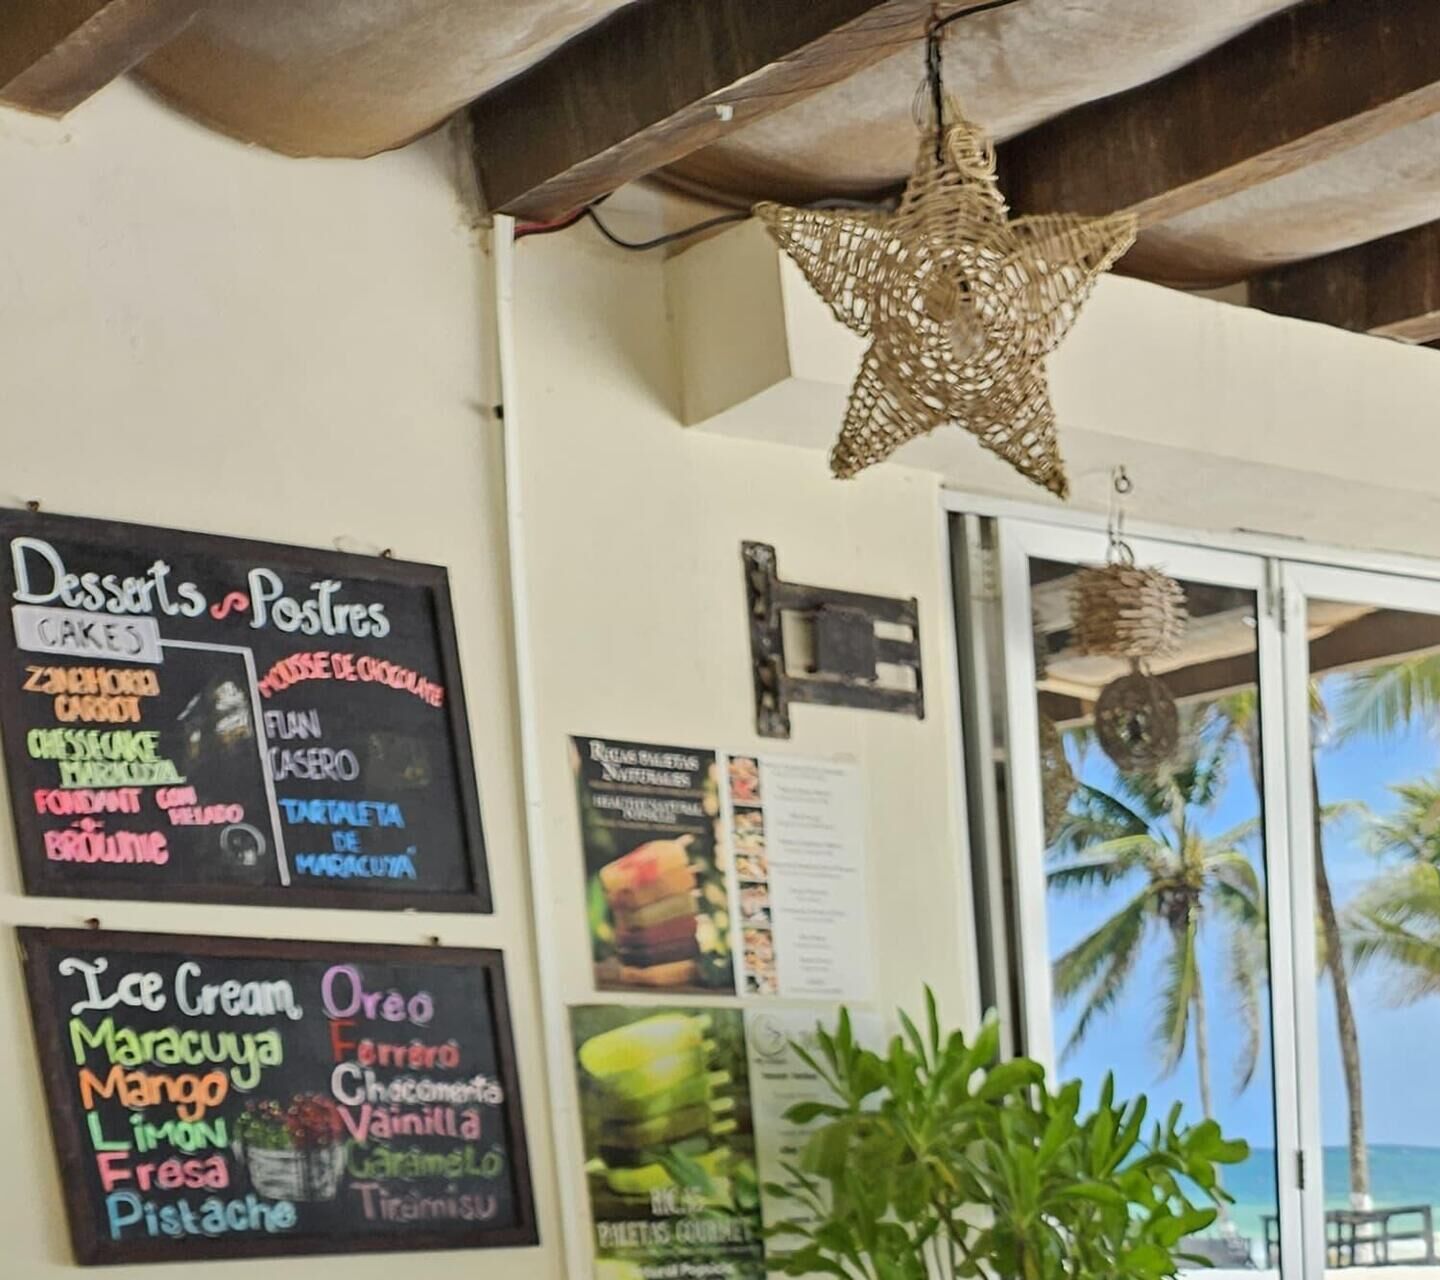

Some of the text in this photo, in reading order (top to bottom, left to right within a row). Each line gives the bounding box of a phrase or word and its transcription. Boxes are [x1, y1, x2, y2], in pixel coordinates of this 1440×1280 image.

[10, 537, 391, 638] Desserts Postres
[37, 617, 144, 655] CAKES
[264, 709, 321, 739] FLAN
[267, 746, 360, 782] CASERO
[332, 829, 361, 853] DE
[59, 956, 303, 1020] Ice Cream
[321, 964, 434, 1026] Oreo
[69, 1017, 284, 1091] Maracuya
[329, 1018, 461, 1070] Ferrero
[80, 1064, 229, 1122] Mango
[336, 1104, 481, 1142] Vainilla
[97, 1151, 230, 1192] Fresa
[350, 1180, 498, 1222] Tiramisu
